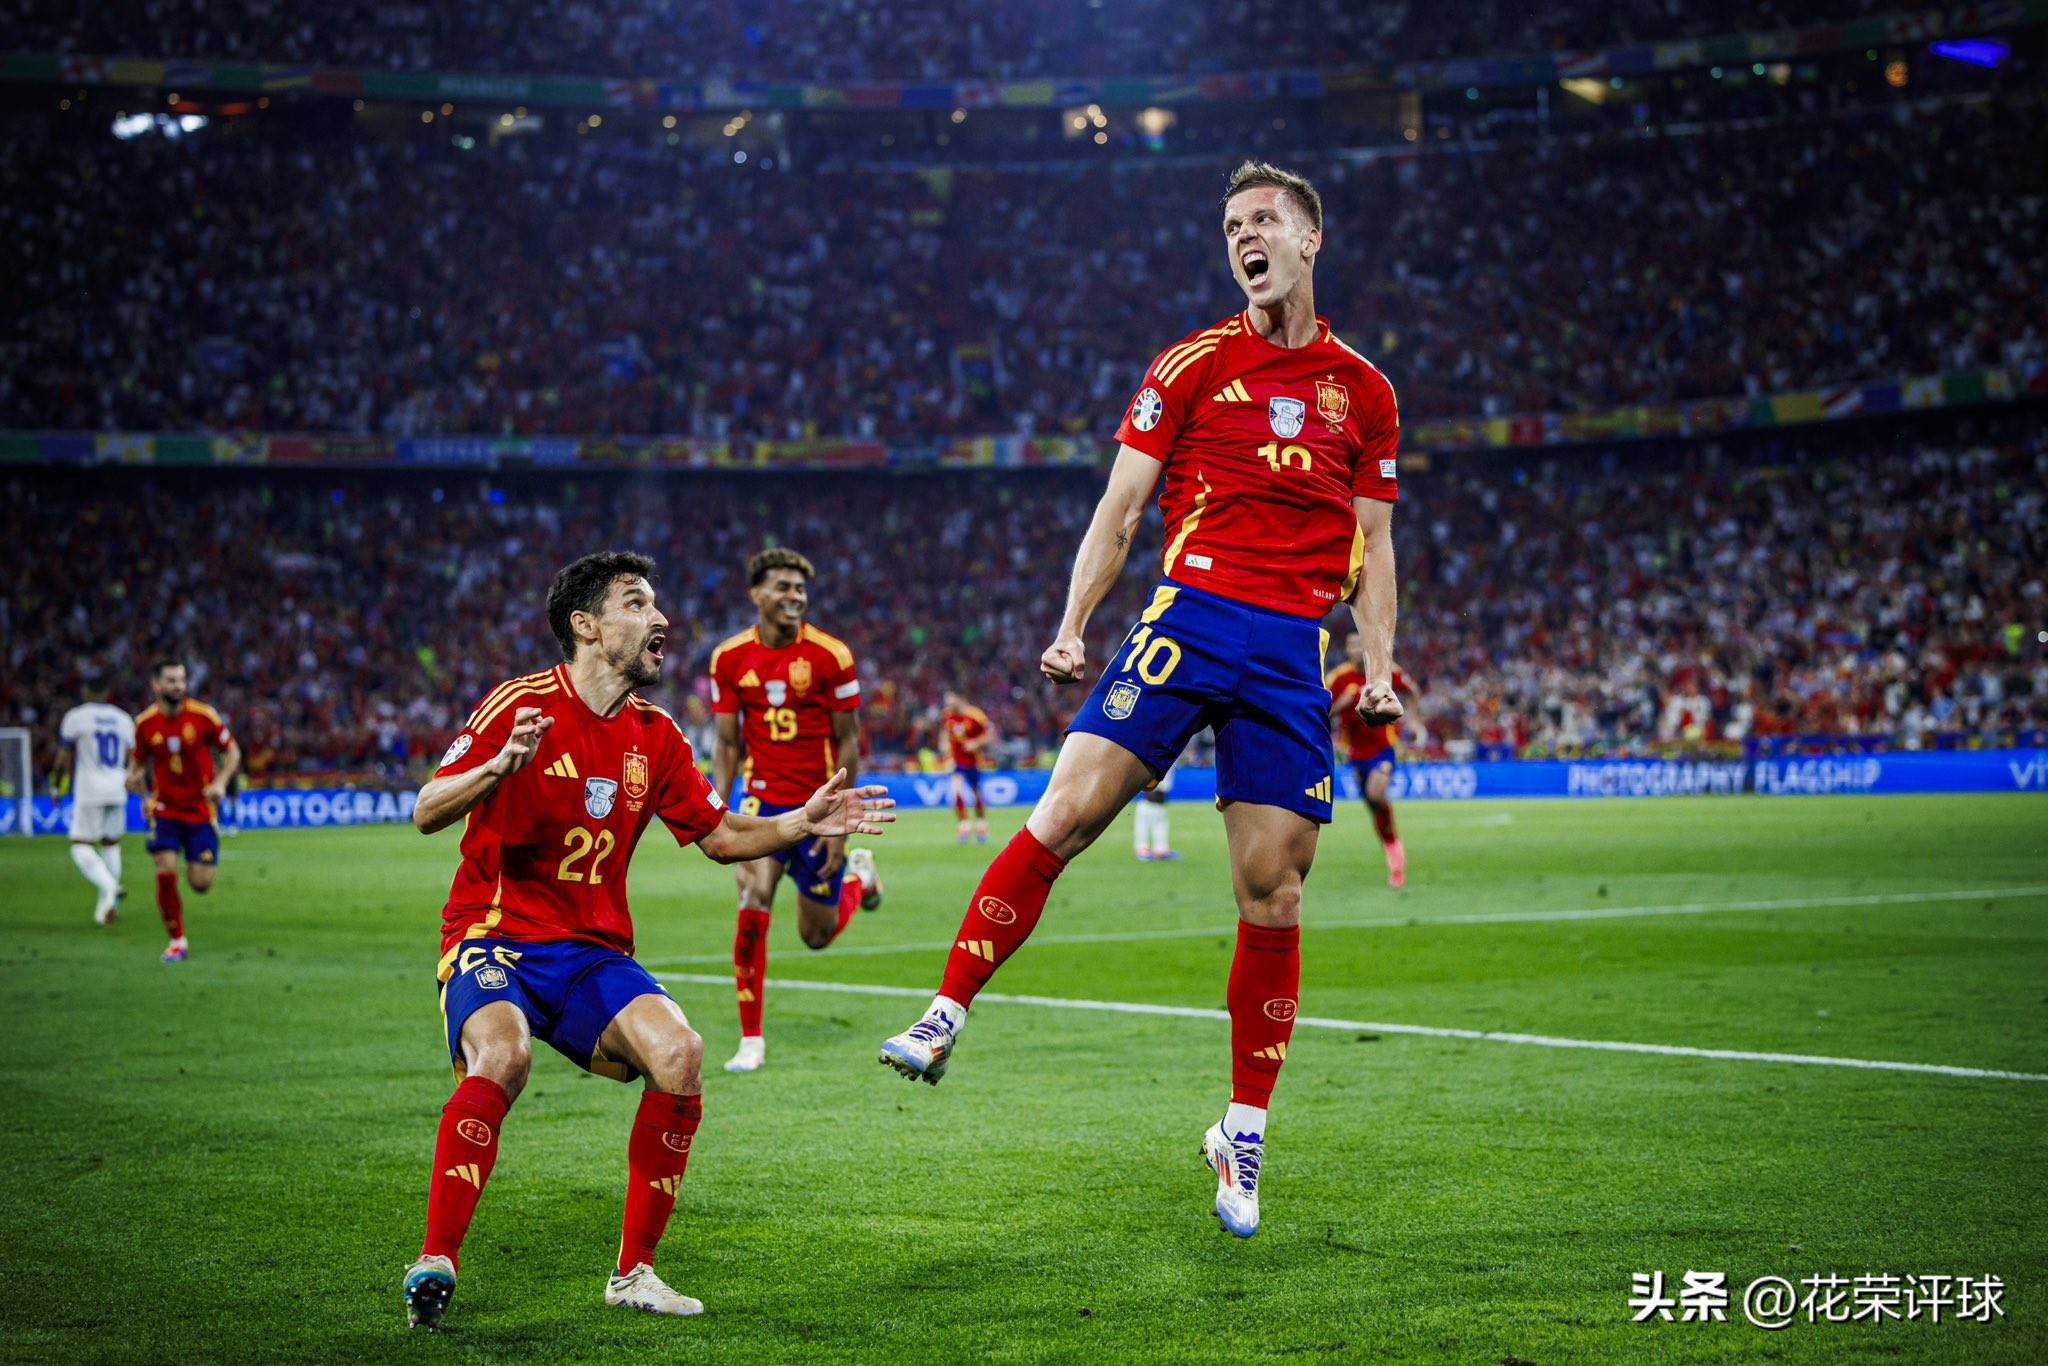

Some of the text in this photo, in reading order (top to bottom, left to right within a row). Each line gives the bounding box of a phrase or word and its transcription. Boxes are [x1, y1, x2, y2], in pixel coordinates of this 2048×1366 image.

[1121, 626, 1182, 685] 10
[763, 707, 798, 741] 19
[95, 731, 120, 768] 10
[557, 826, 616, 885] 22
